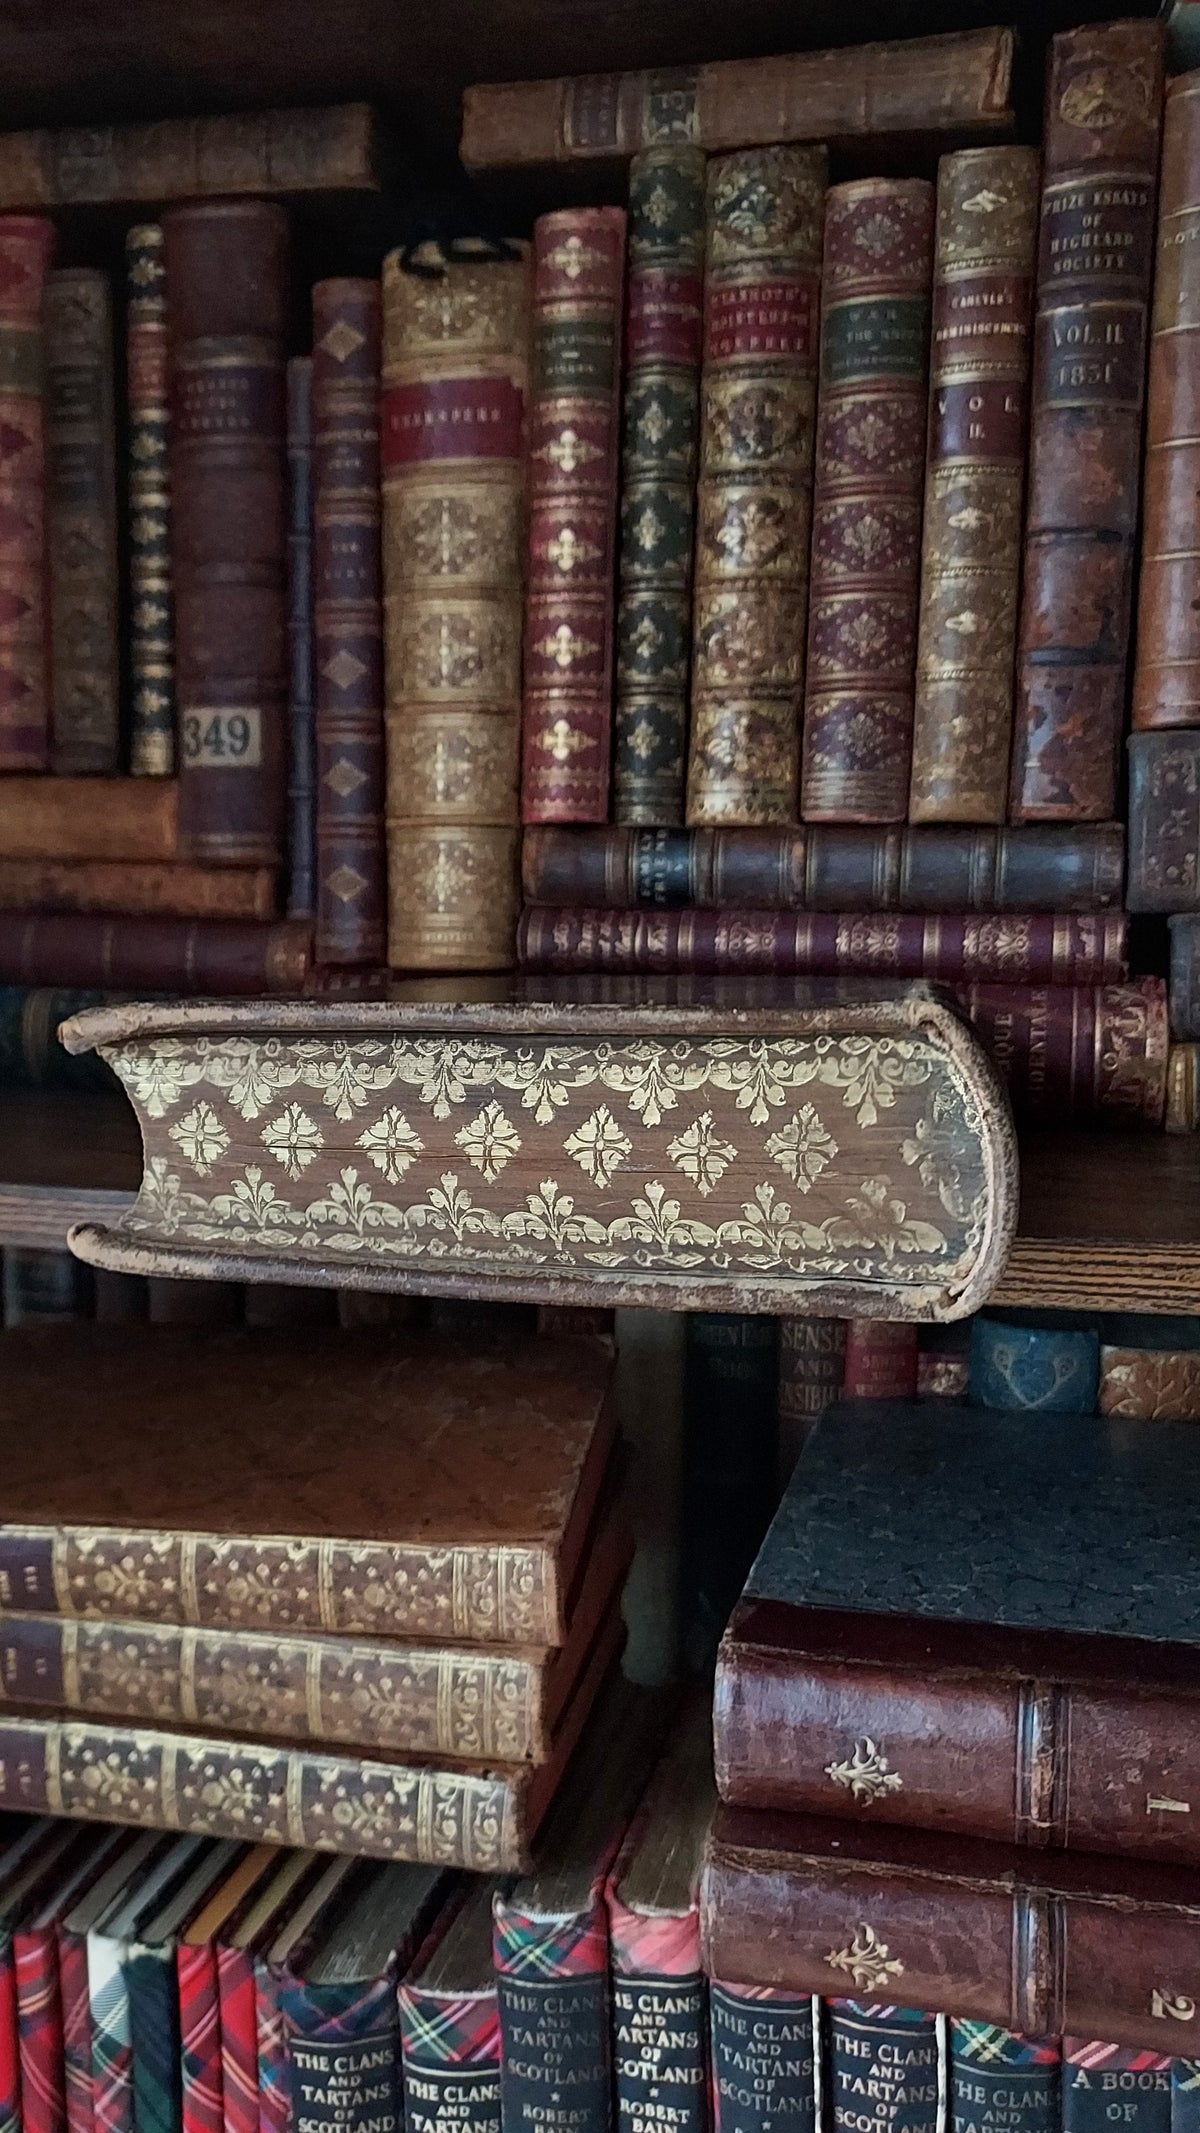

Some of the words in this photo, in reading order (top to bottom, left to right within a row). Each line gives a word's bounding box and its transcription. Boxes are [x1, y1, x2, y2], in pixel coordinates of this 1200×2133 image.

[1043, 192, 1085, 216] PRIZE
[1093, 188, 1148, 207] ESSAYS
[1082, 212, 1104, 229] OF
[1050, 232, 1134, 255] HIGHLAND
[1053, 254, 1125, 275] SOCIETY
[181, 714, 252, 758] 349
[793, 1358, 835, 1378] AND
[502, 1989, 538, 2013] THE
[543, 1996, 597, 2014] CLAN
[637, 1994, 701, 2014] CLANS
[1150, 1987, 1196, 2022] 2
[537, 2015, 571, 2029] AND
[630, 2012, 667, 2027] AND
[714, 2003, 748, 2036] THE
[616, 2024, 699, 2049] ARTANS
[832, 2031, 872, 2059] THE
[543, 2051, 563, 2065] OF
[640, 2045, 662, 2063] OF
[745, 2040, 783, 2056] AND
[292, 2051, 330, 2073] THE
[333, 2048, 395, 2074] CLANS
[614, 2055, 704, 2085] COTLAND
[719, 2042, 813, 2077] TARTANS
[327, 2074, 362, 2088] AND
[868, 2062, 906, 2081] AND
[1071, 2068, 1093, 2090] A
[1101, 2071, 1170, 2091] BOOK
[300, 2081, 391, 2107] TARTANS
[405, 2075, 440, 2102] THE
[443, 2083, 501, 2103] CLANS
[753, 2077, 776, 2092] OF
[837, 2070, 937, 2104] TARTANS
[992, 2089, 1049, 2109] CLAN
[333, 2108, 355, 2122] OF
[436, 2104, 471, 2118] AND
[522, 2102, 591, 2124] ROBERT
[619, 2096, 691, 2124] ROBERT
[834, 2105, 937, 2133] SCOTLAN
[876, 2102, 899, 2120] OF
[981, 2109, 1022, 2124] AND
[1106, 2103, 1139, 2122] OF
[298, 2114, 396, 2133] SCOTLAND
[410, 2111, 500, 2133] TARTANS
[631, 2116, 678, 2133] BAIN
